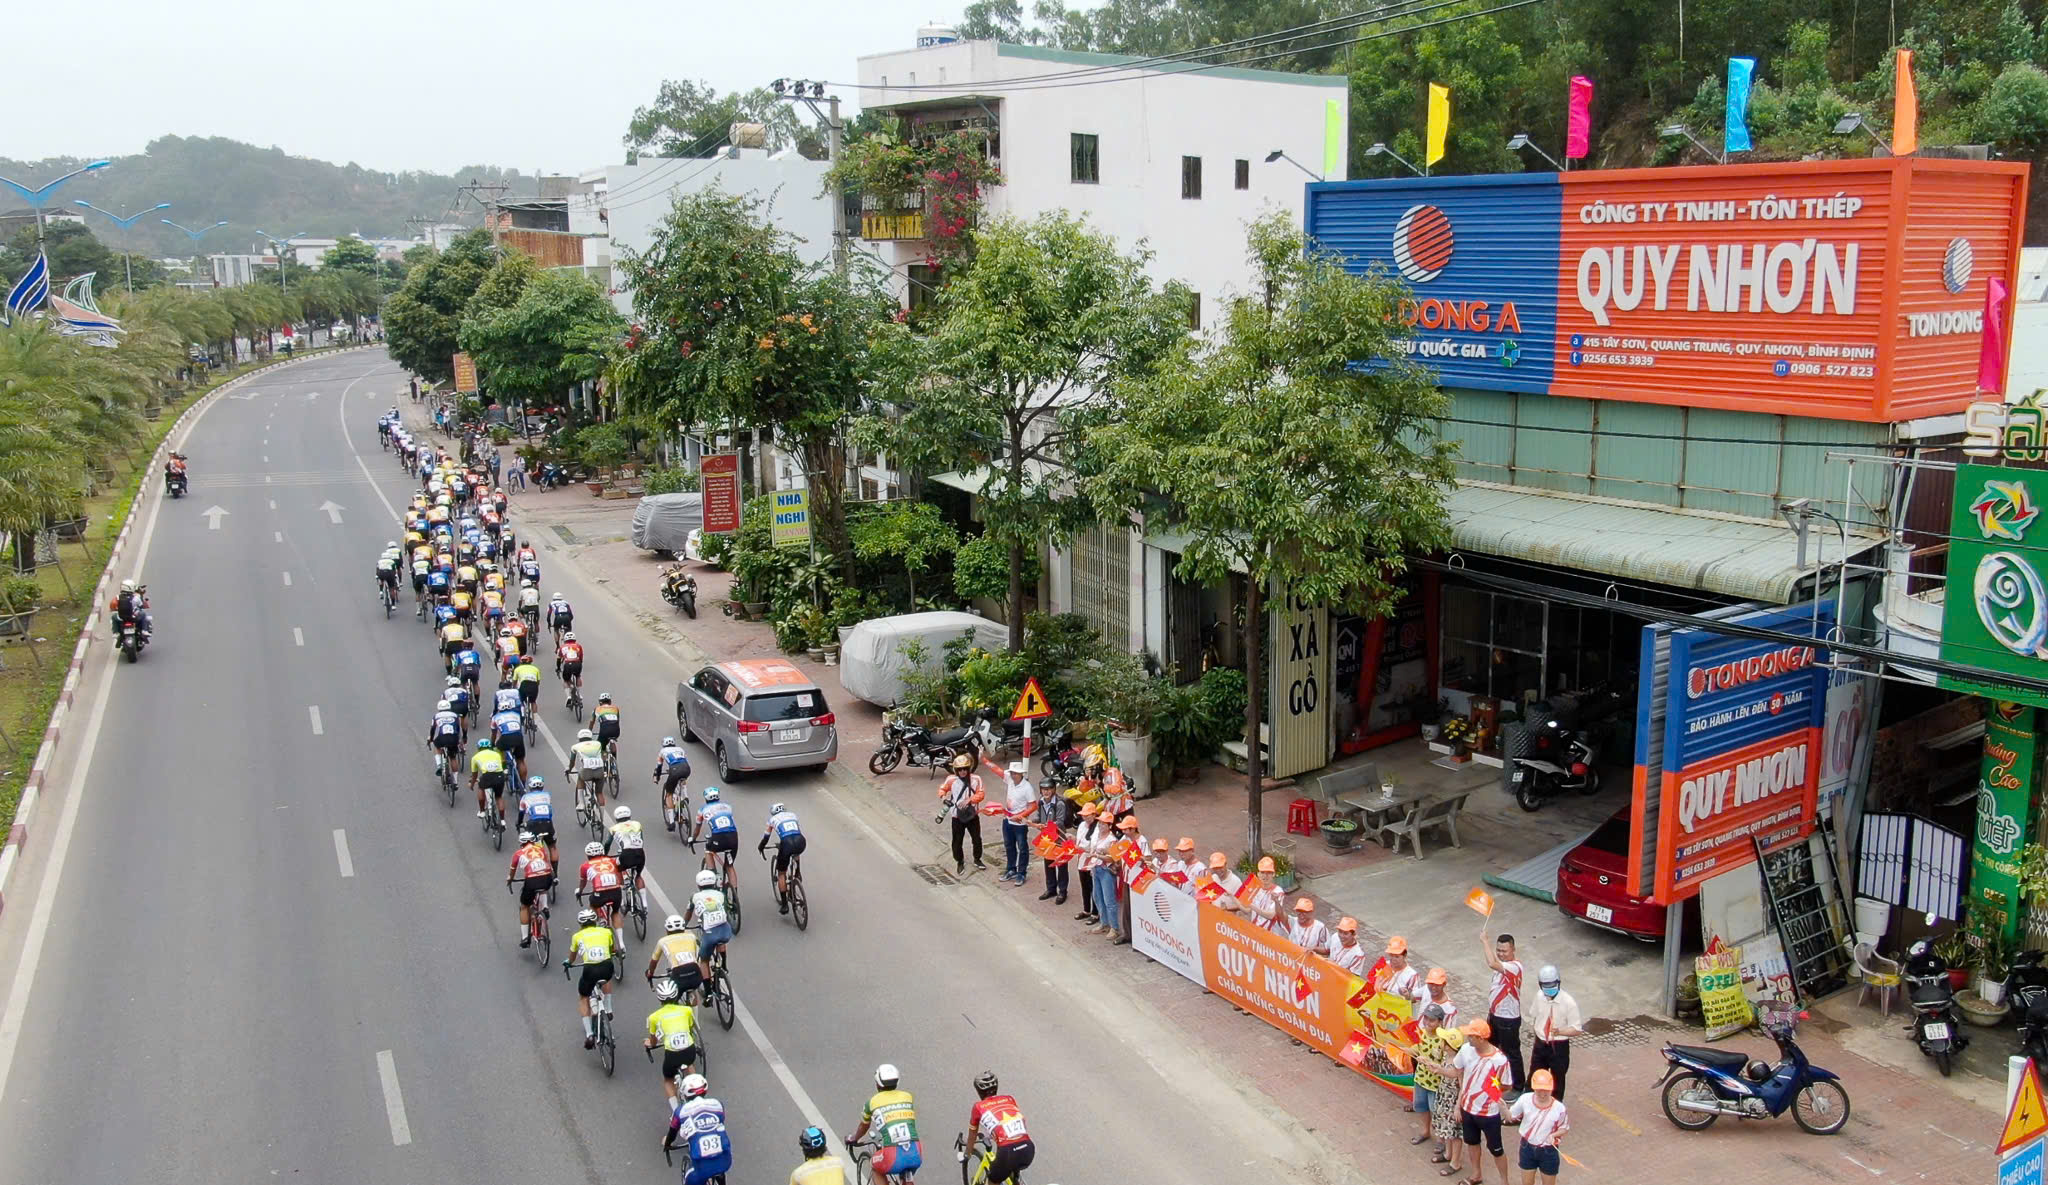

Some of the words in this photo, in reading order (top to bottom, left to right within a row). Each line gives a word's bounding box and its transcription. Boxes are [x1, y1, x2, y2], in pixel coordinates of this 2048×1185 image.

[1579, 200, 1636, 224] CÔNG
[1641, 202, 1668, 222] TY
[1674, 201, 1735, 222] TNHH
[1802, 191, 1863, 219] THÉP
[1576, 245, 1681, 327] QUY
[1687, 238, 1860, 316] NHƠN
[1397, 298, 1490, 333] DONG
[1494, 301, 1522, 334] A
[1418, 338, 1458, 358] QUỐC
[1460, 343, 1487, 359] GIA
[1583, 337, 1600, 348] 415
[1601, 336, 1620, 349] TÂY
[1621, 338, 1649, 352] SƠN,
[1650, 340, 1691, 352] QUANG
[1693, 341, 1733, 356] TRUNG,
[1736, 343, 1762, 356] QUY
[1764, 343, 1805, 358] NHƠN,
[1808, 343, 1838, 358] BÌNH
[1841, 346, 1875, 361] ĐỊNH
[1790, 363, 1821, 375] 0906
[1825, 364, 1848, 376] 527
[1849, 366, 1875, 378] 823
[1678, 769, 1731, 834] QUY
[1733, 743, 1807, 808] NHƠN
[1215, 921, 1239, 942] CÔNG
[1240, 933, 1251, 946] TY
[1250, 939, 1276, 961] TNHH
[1217, 943, 1257, 984] QUY
[1217, 975, 1244, 998] CHÀO
[1245, 989, 1276, 1015] MỪNG
[1276, 1007, 1308, 1033] ĐOÀN
[1308, 1023, 1333, 1047] ĐUA
[672, 1034, 687, 1047] 67
[702, 1136, 720, 1152] 93
